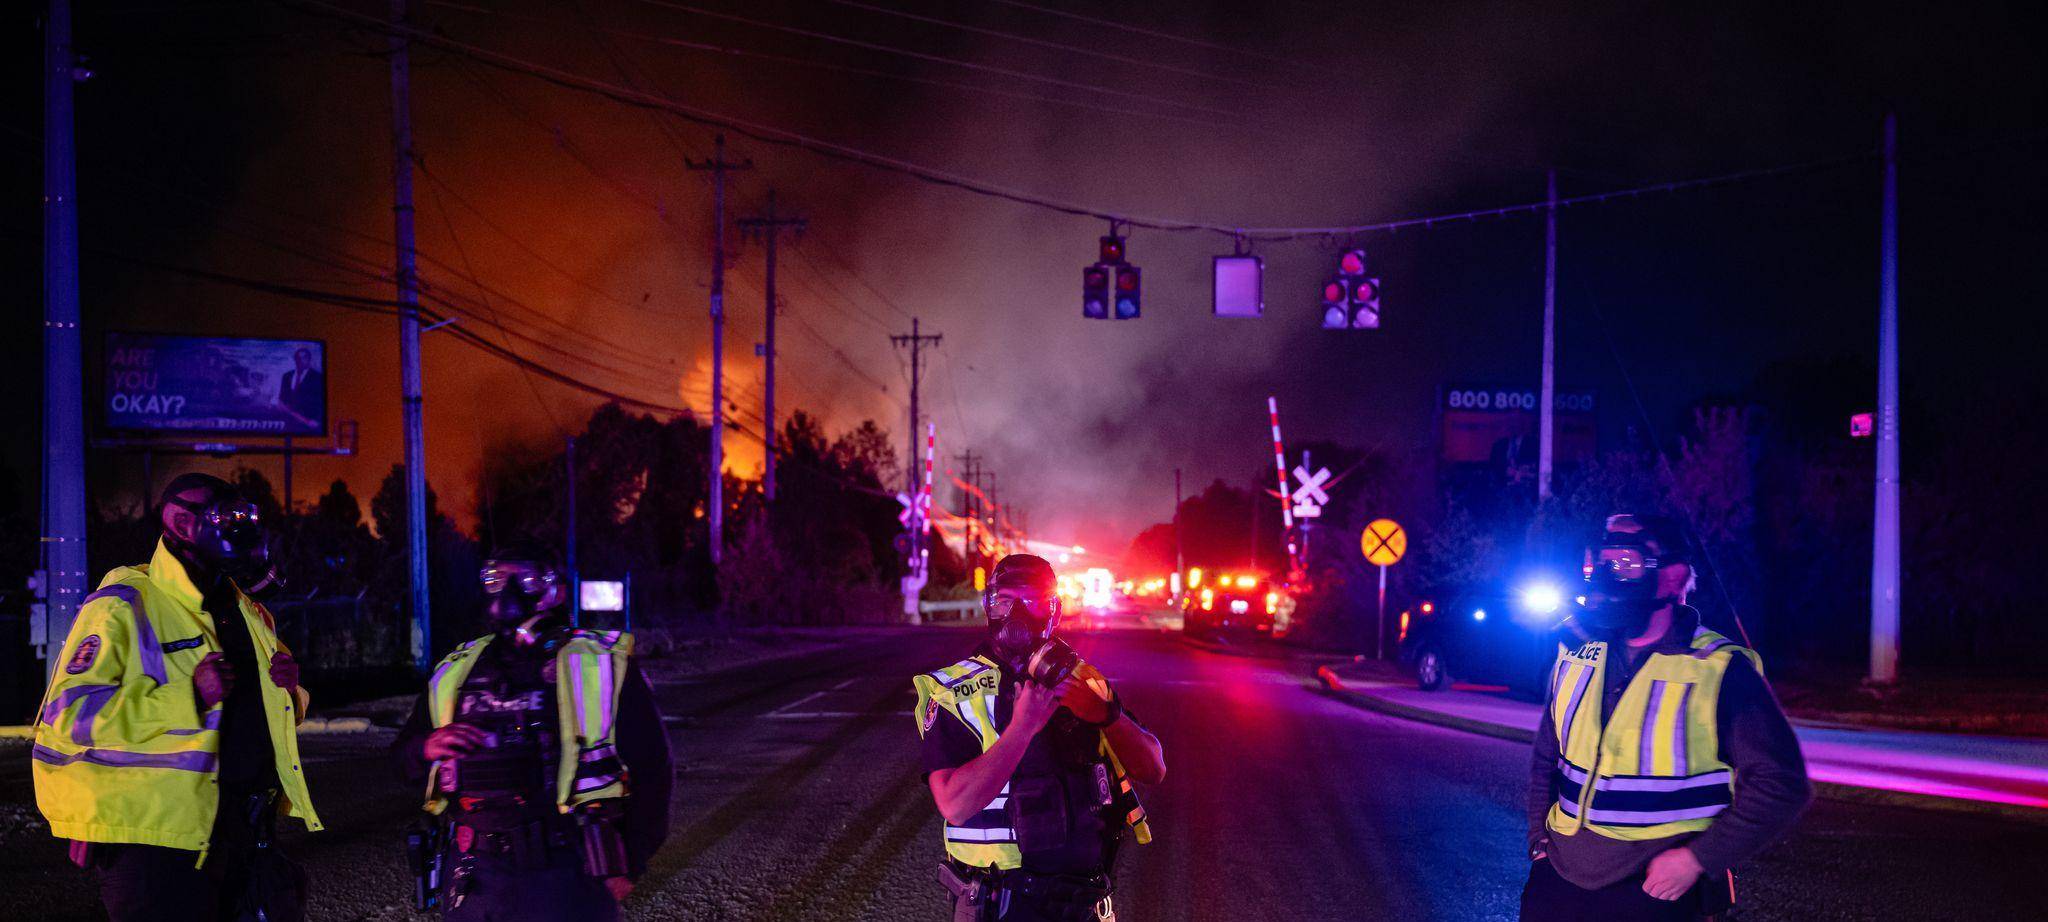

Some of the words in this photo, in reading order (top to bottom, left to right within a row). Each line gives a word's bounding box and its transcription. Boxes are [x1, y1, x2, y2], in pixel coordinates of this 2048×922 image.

[110, 347, 156, 368] ARE
[112, 368, 158, 390] YOU
[112, 393, 186, 414] OKAY?
[1449, 390, 1490, 409] 800
[1494, 392, 1536, 410] 800
[1549, 393, 1593, 411] 600
[953, 675, 996, 697] POLICE
